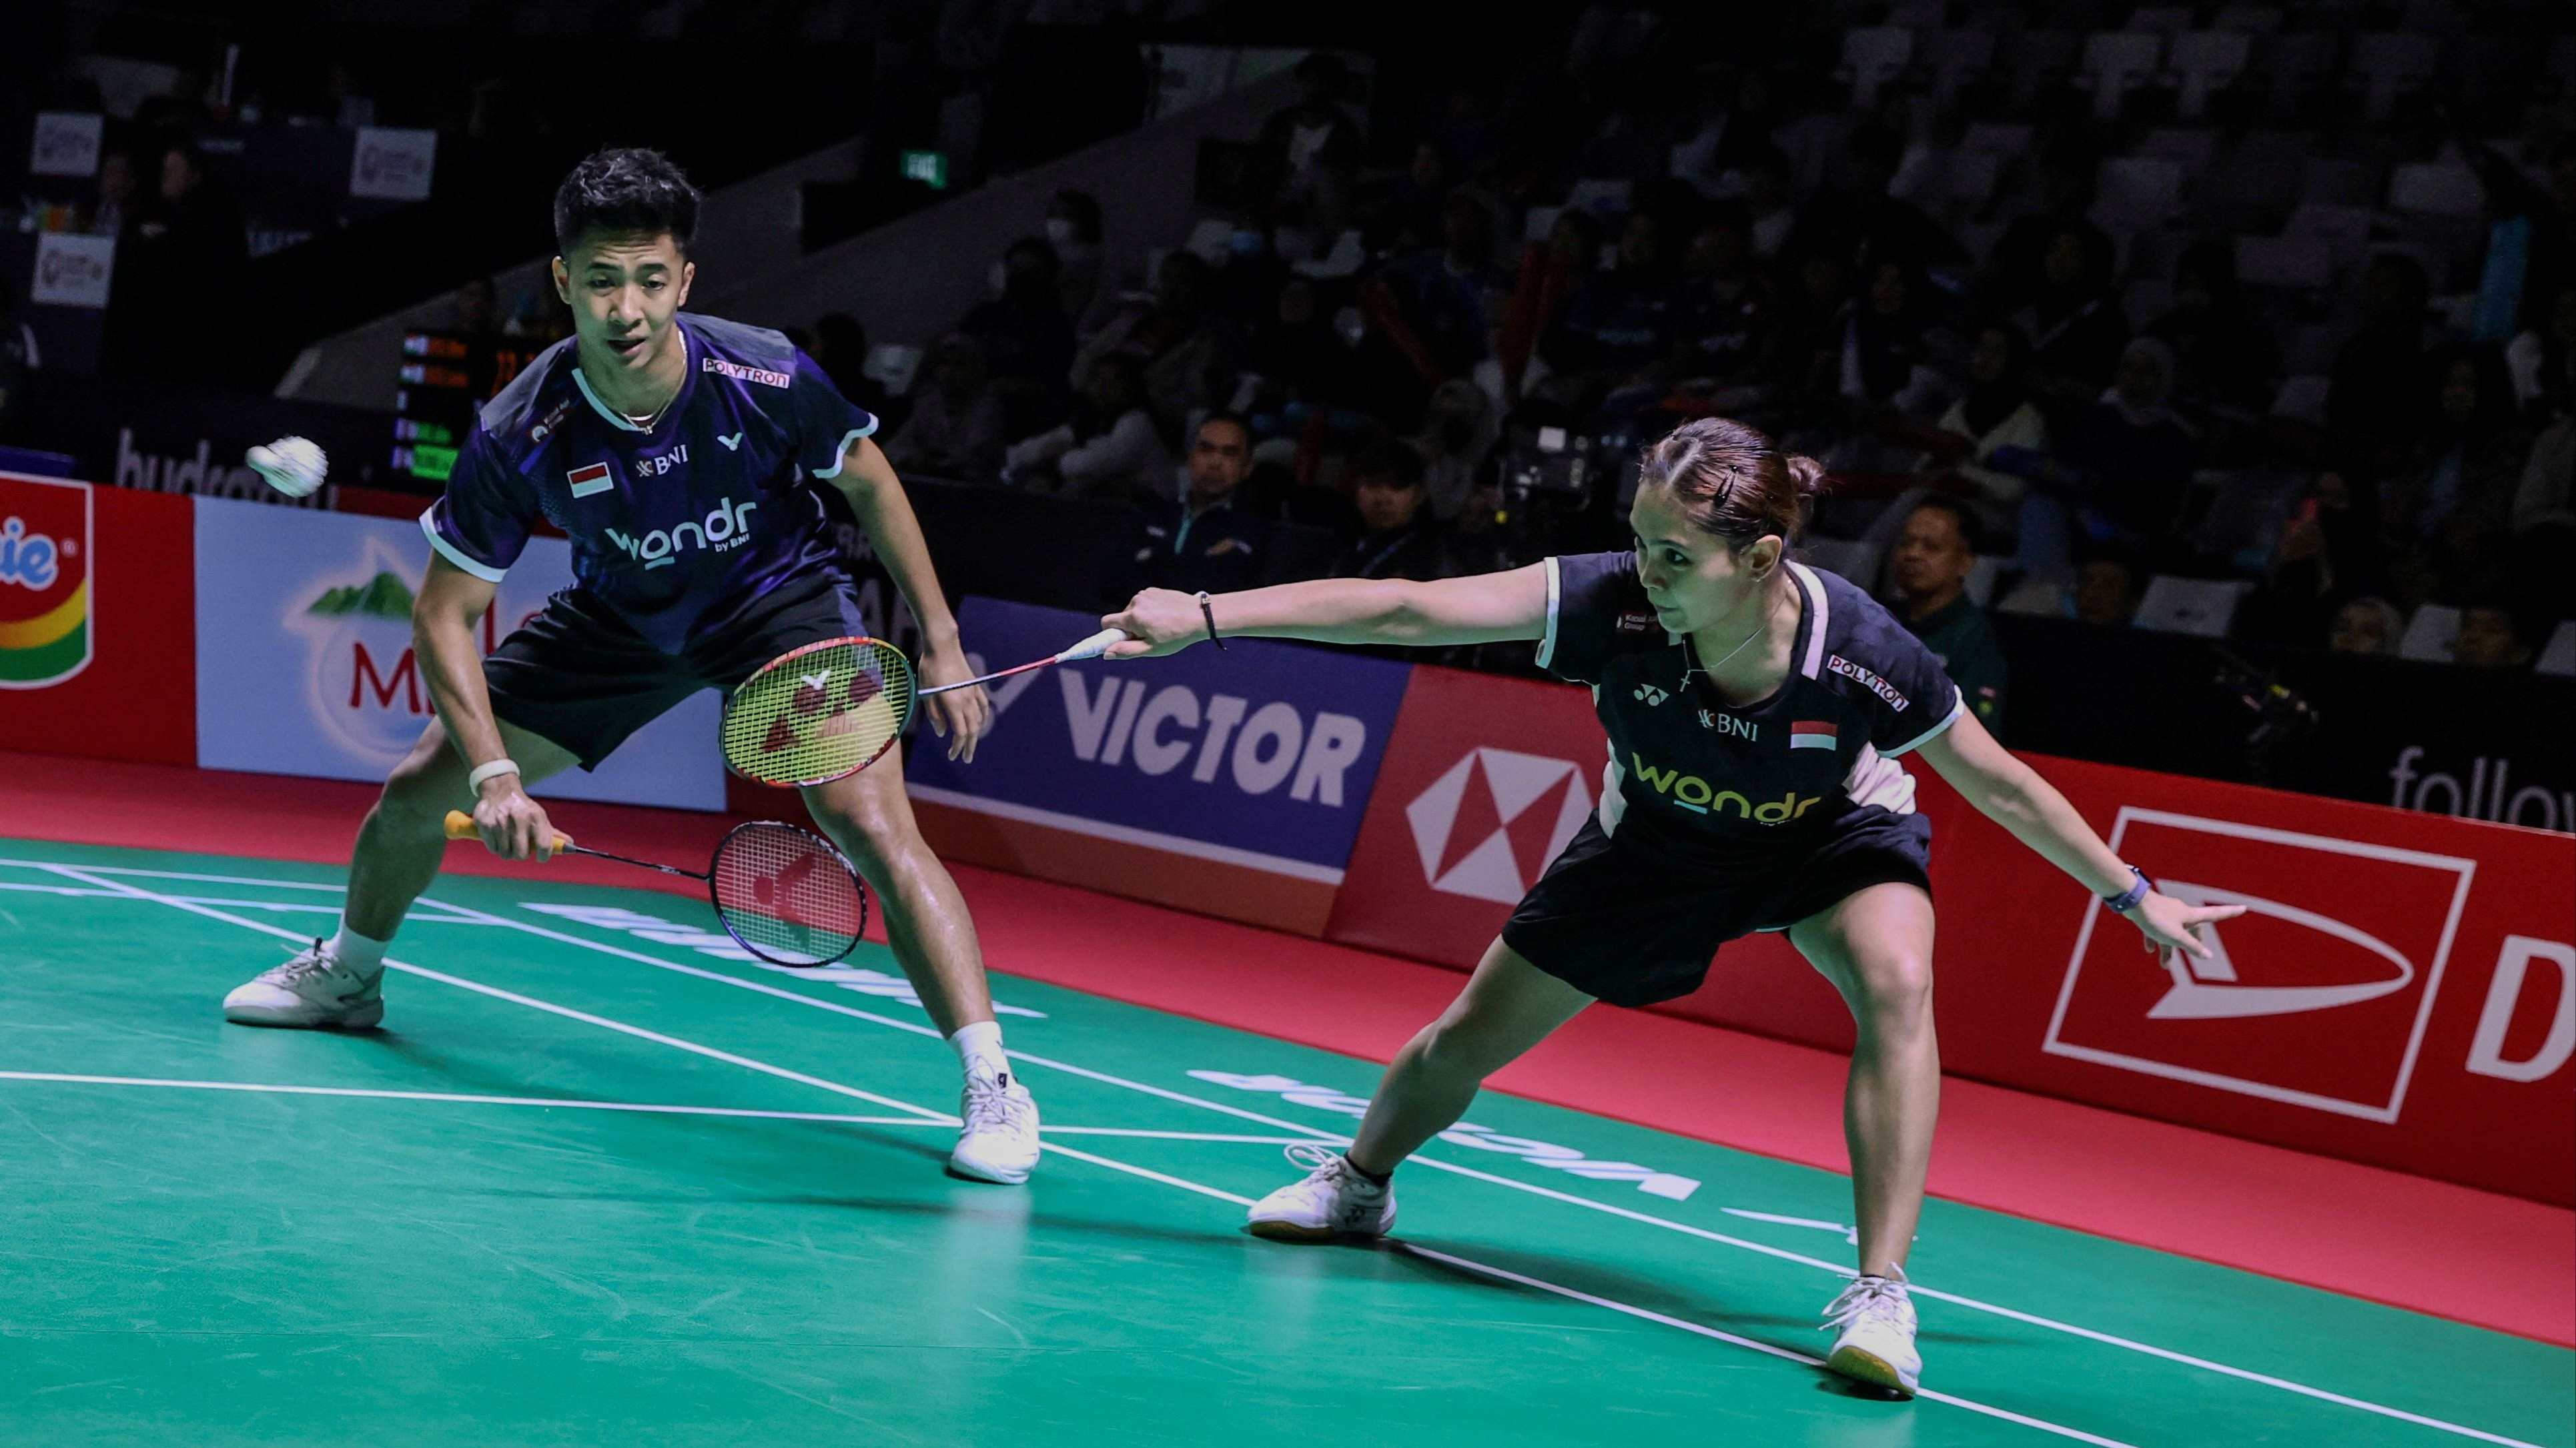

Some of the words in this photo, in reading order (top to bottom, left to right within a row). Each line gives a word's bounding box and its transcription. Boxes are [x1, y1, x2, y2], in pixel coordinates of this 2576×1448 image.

[705, 359, 787, 388] POLYTRON
[654, 444, 689, 476] BNI
[604, 496, 757, 570] wondr
[714, 542, 729, 553] by
[729, 532, 750, 548] BNI
[1830, 656, 1905, 710] POLYTRON
[1057, 668, 1366, 808] VICTOR
[1717, 712, 1759, 742] BNI
[1632, 752, 1822, 820] wondr
[2388, 745, 2576, 833] follo
[1185, 1068, 1703, 1202] VICOR
